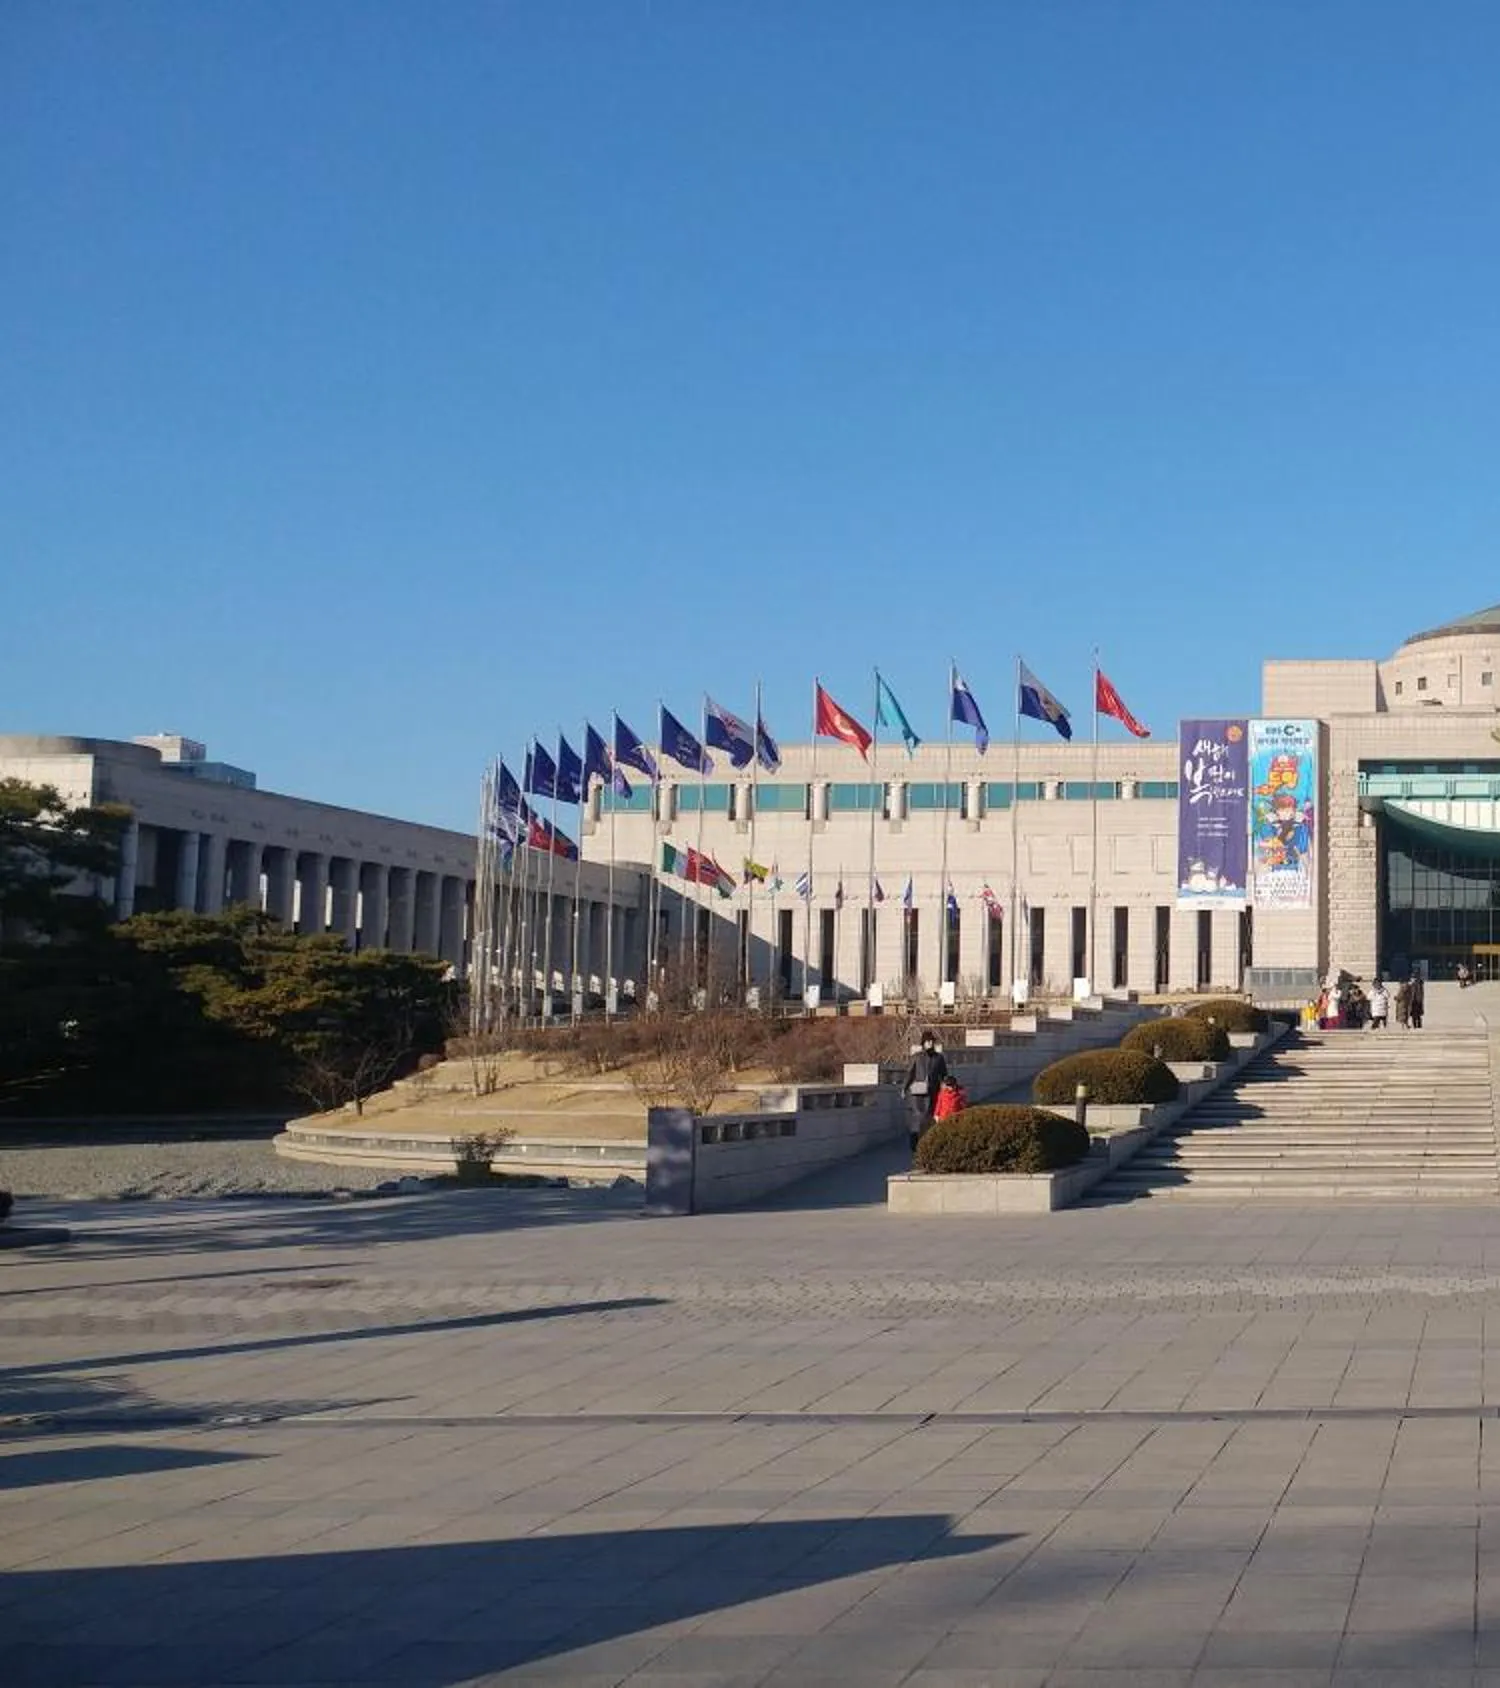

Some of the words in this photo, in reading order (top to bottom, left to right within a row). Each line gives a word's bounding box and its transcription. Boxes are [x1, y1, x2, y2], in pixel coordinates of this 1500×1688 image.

[1191, 738, 1229, 761] 새해
[1185, 757, 1213, 806] 복
[1207, 763, 1236, 783] 많이
